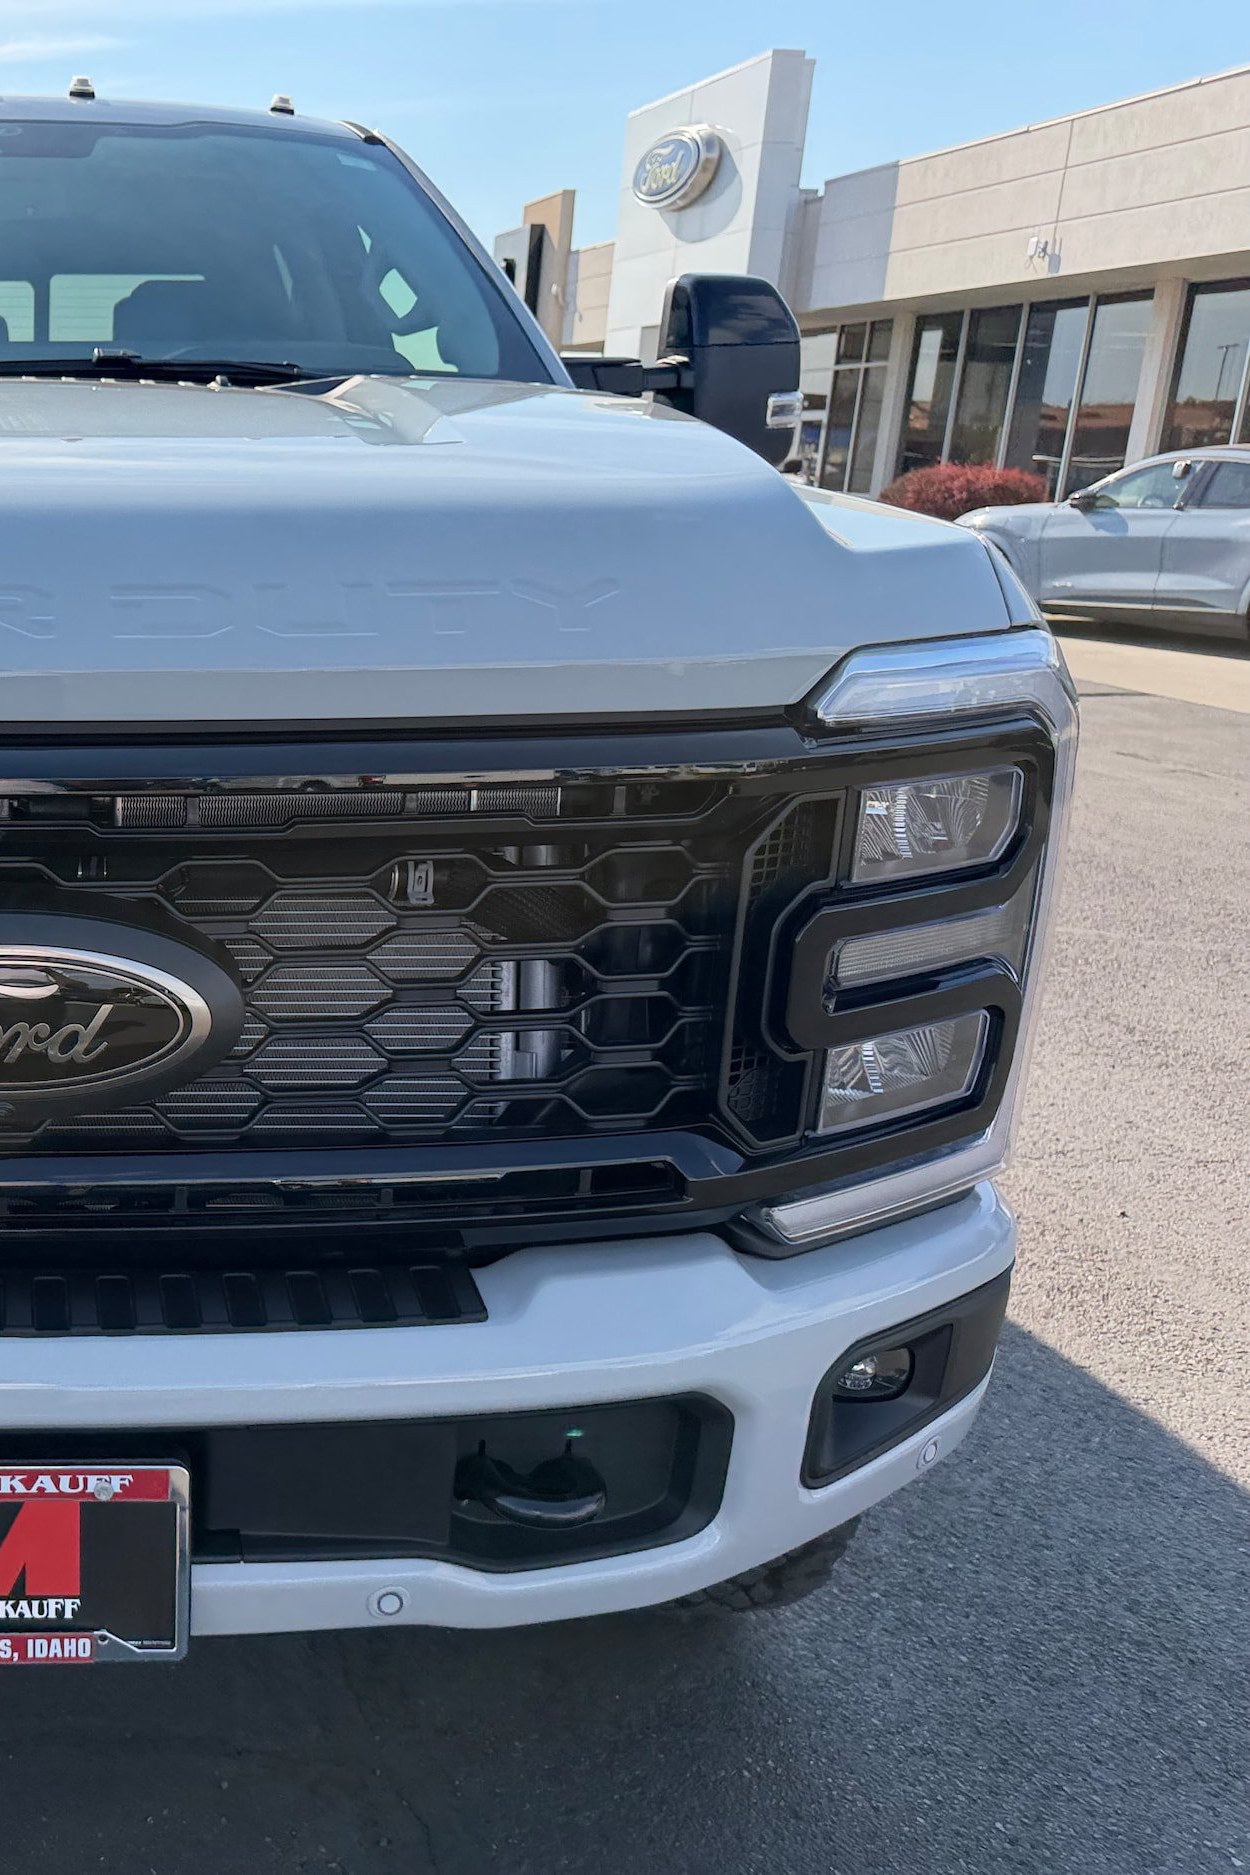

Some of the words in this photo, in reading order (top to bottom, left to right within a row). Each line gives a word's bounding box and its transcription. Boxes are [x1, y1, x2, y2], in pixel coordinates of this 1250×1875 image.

[640, 144, 685, 193] Ford
[109, 577, 620, 640] DUTY
[27, 1637, 92, 1658] IDAHO
